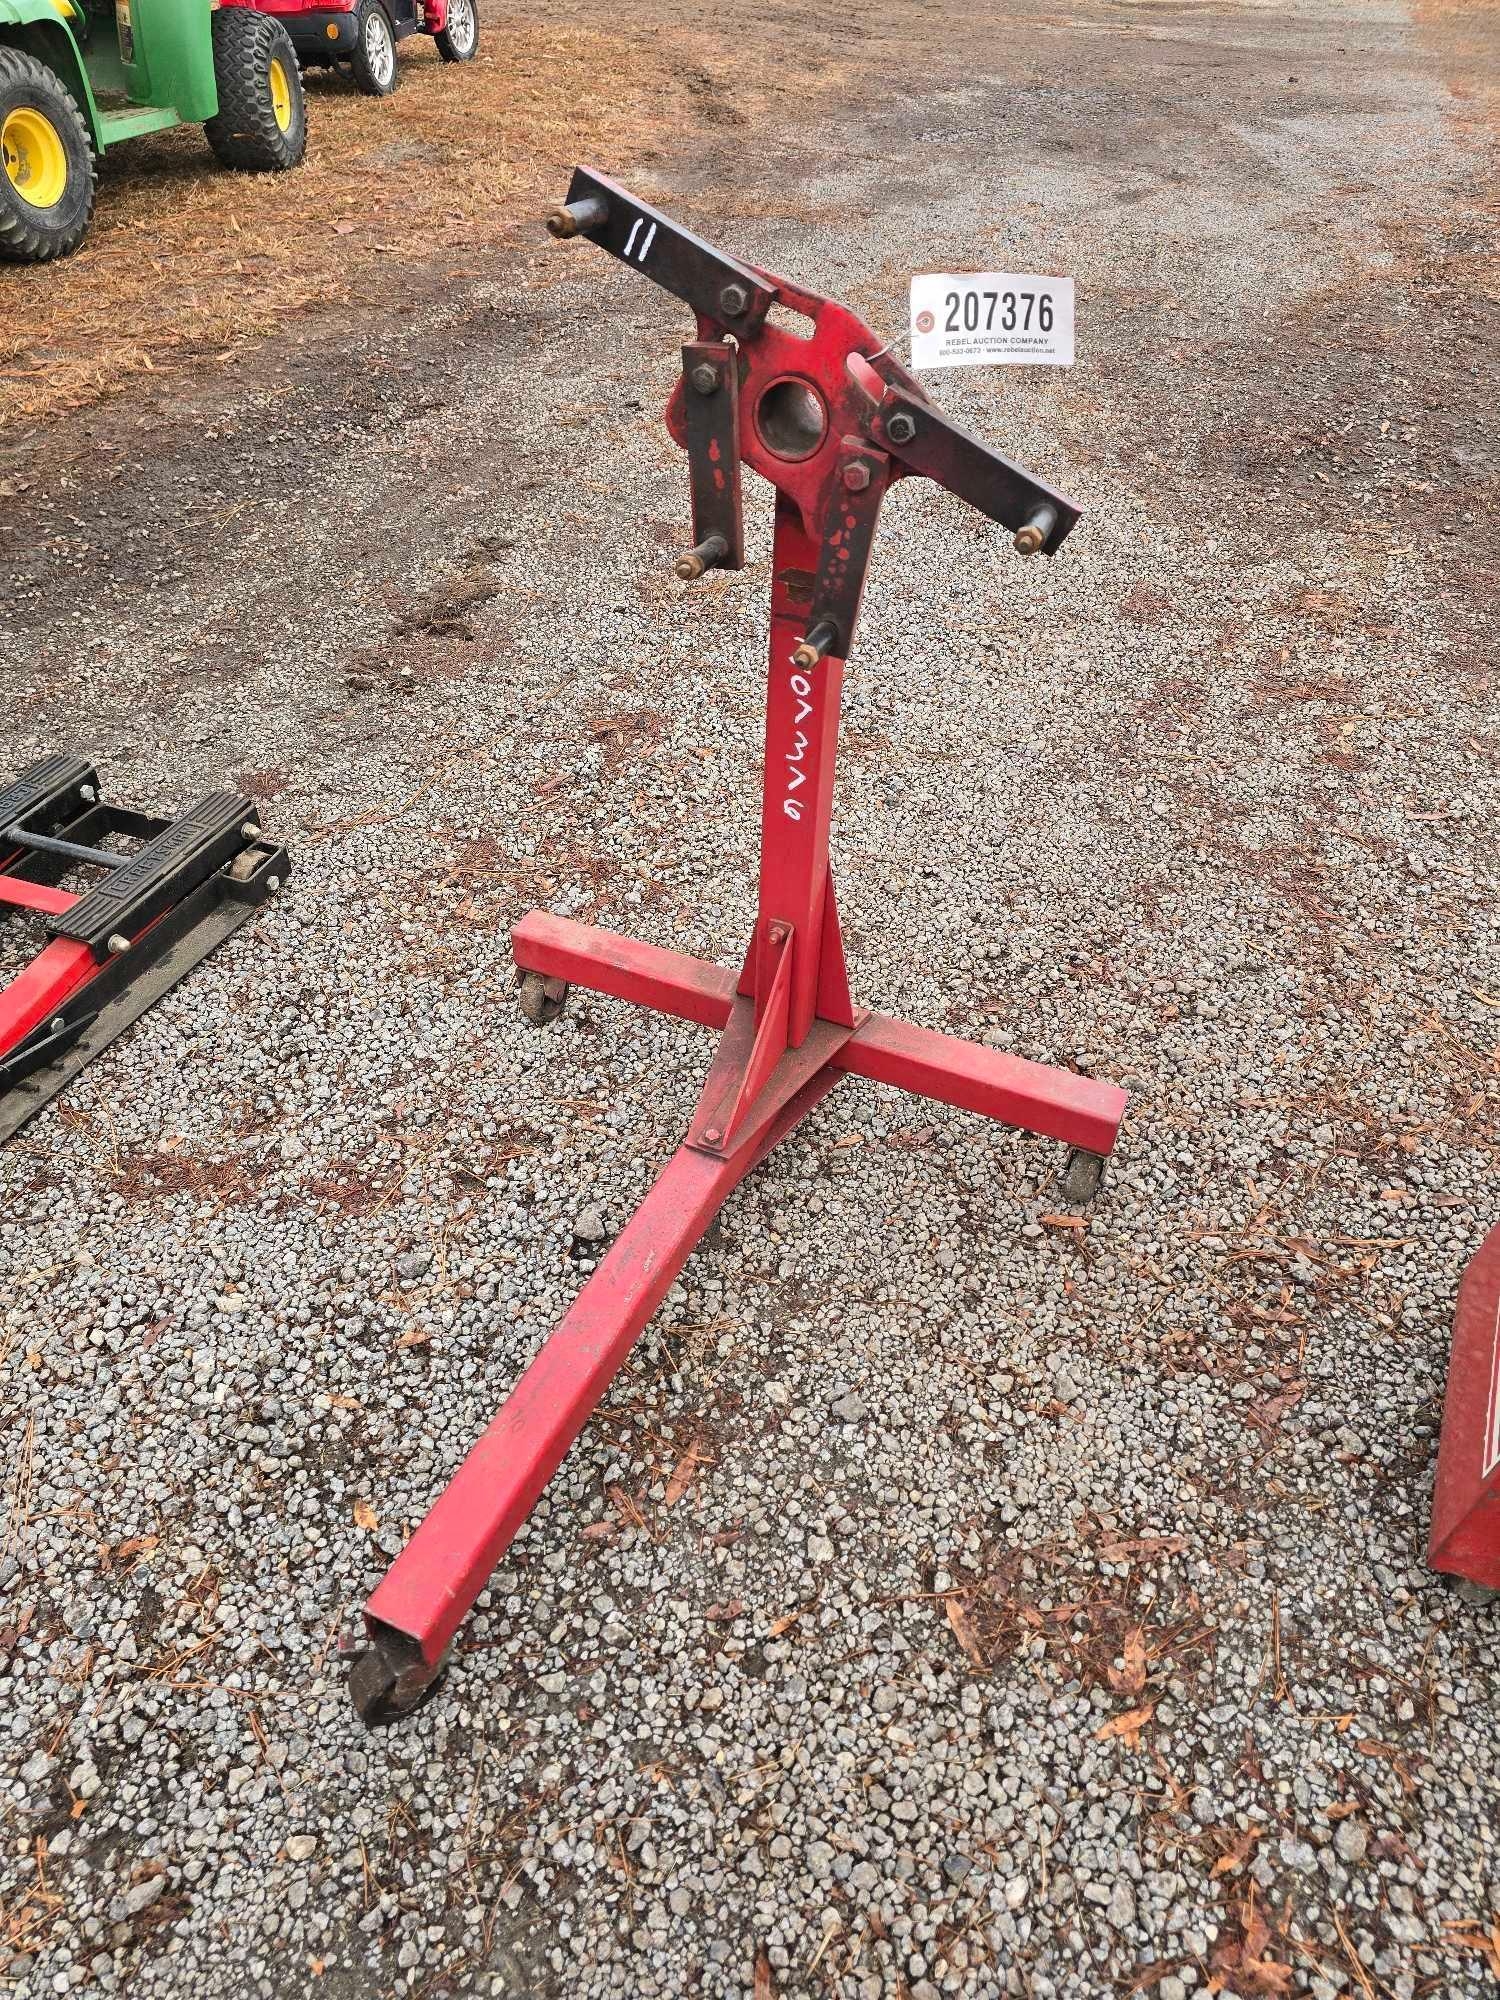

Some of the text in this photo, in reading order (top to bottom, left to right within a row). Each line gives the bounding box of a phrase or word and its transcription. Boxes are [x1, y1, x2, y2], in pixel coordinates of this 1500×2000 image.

[945, 291, 1054, 333] 207376
[946, 337, 1049, 346] REBEL AUCTION COMPANY
[985, 346, 1055, 354] www.rebelauction.net
[110, 826, 198, 892] CRAFTSMAN
